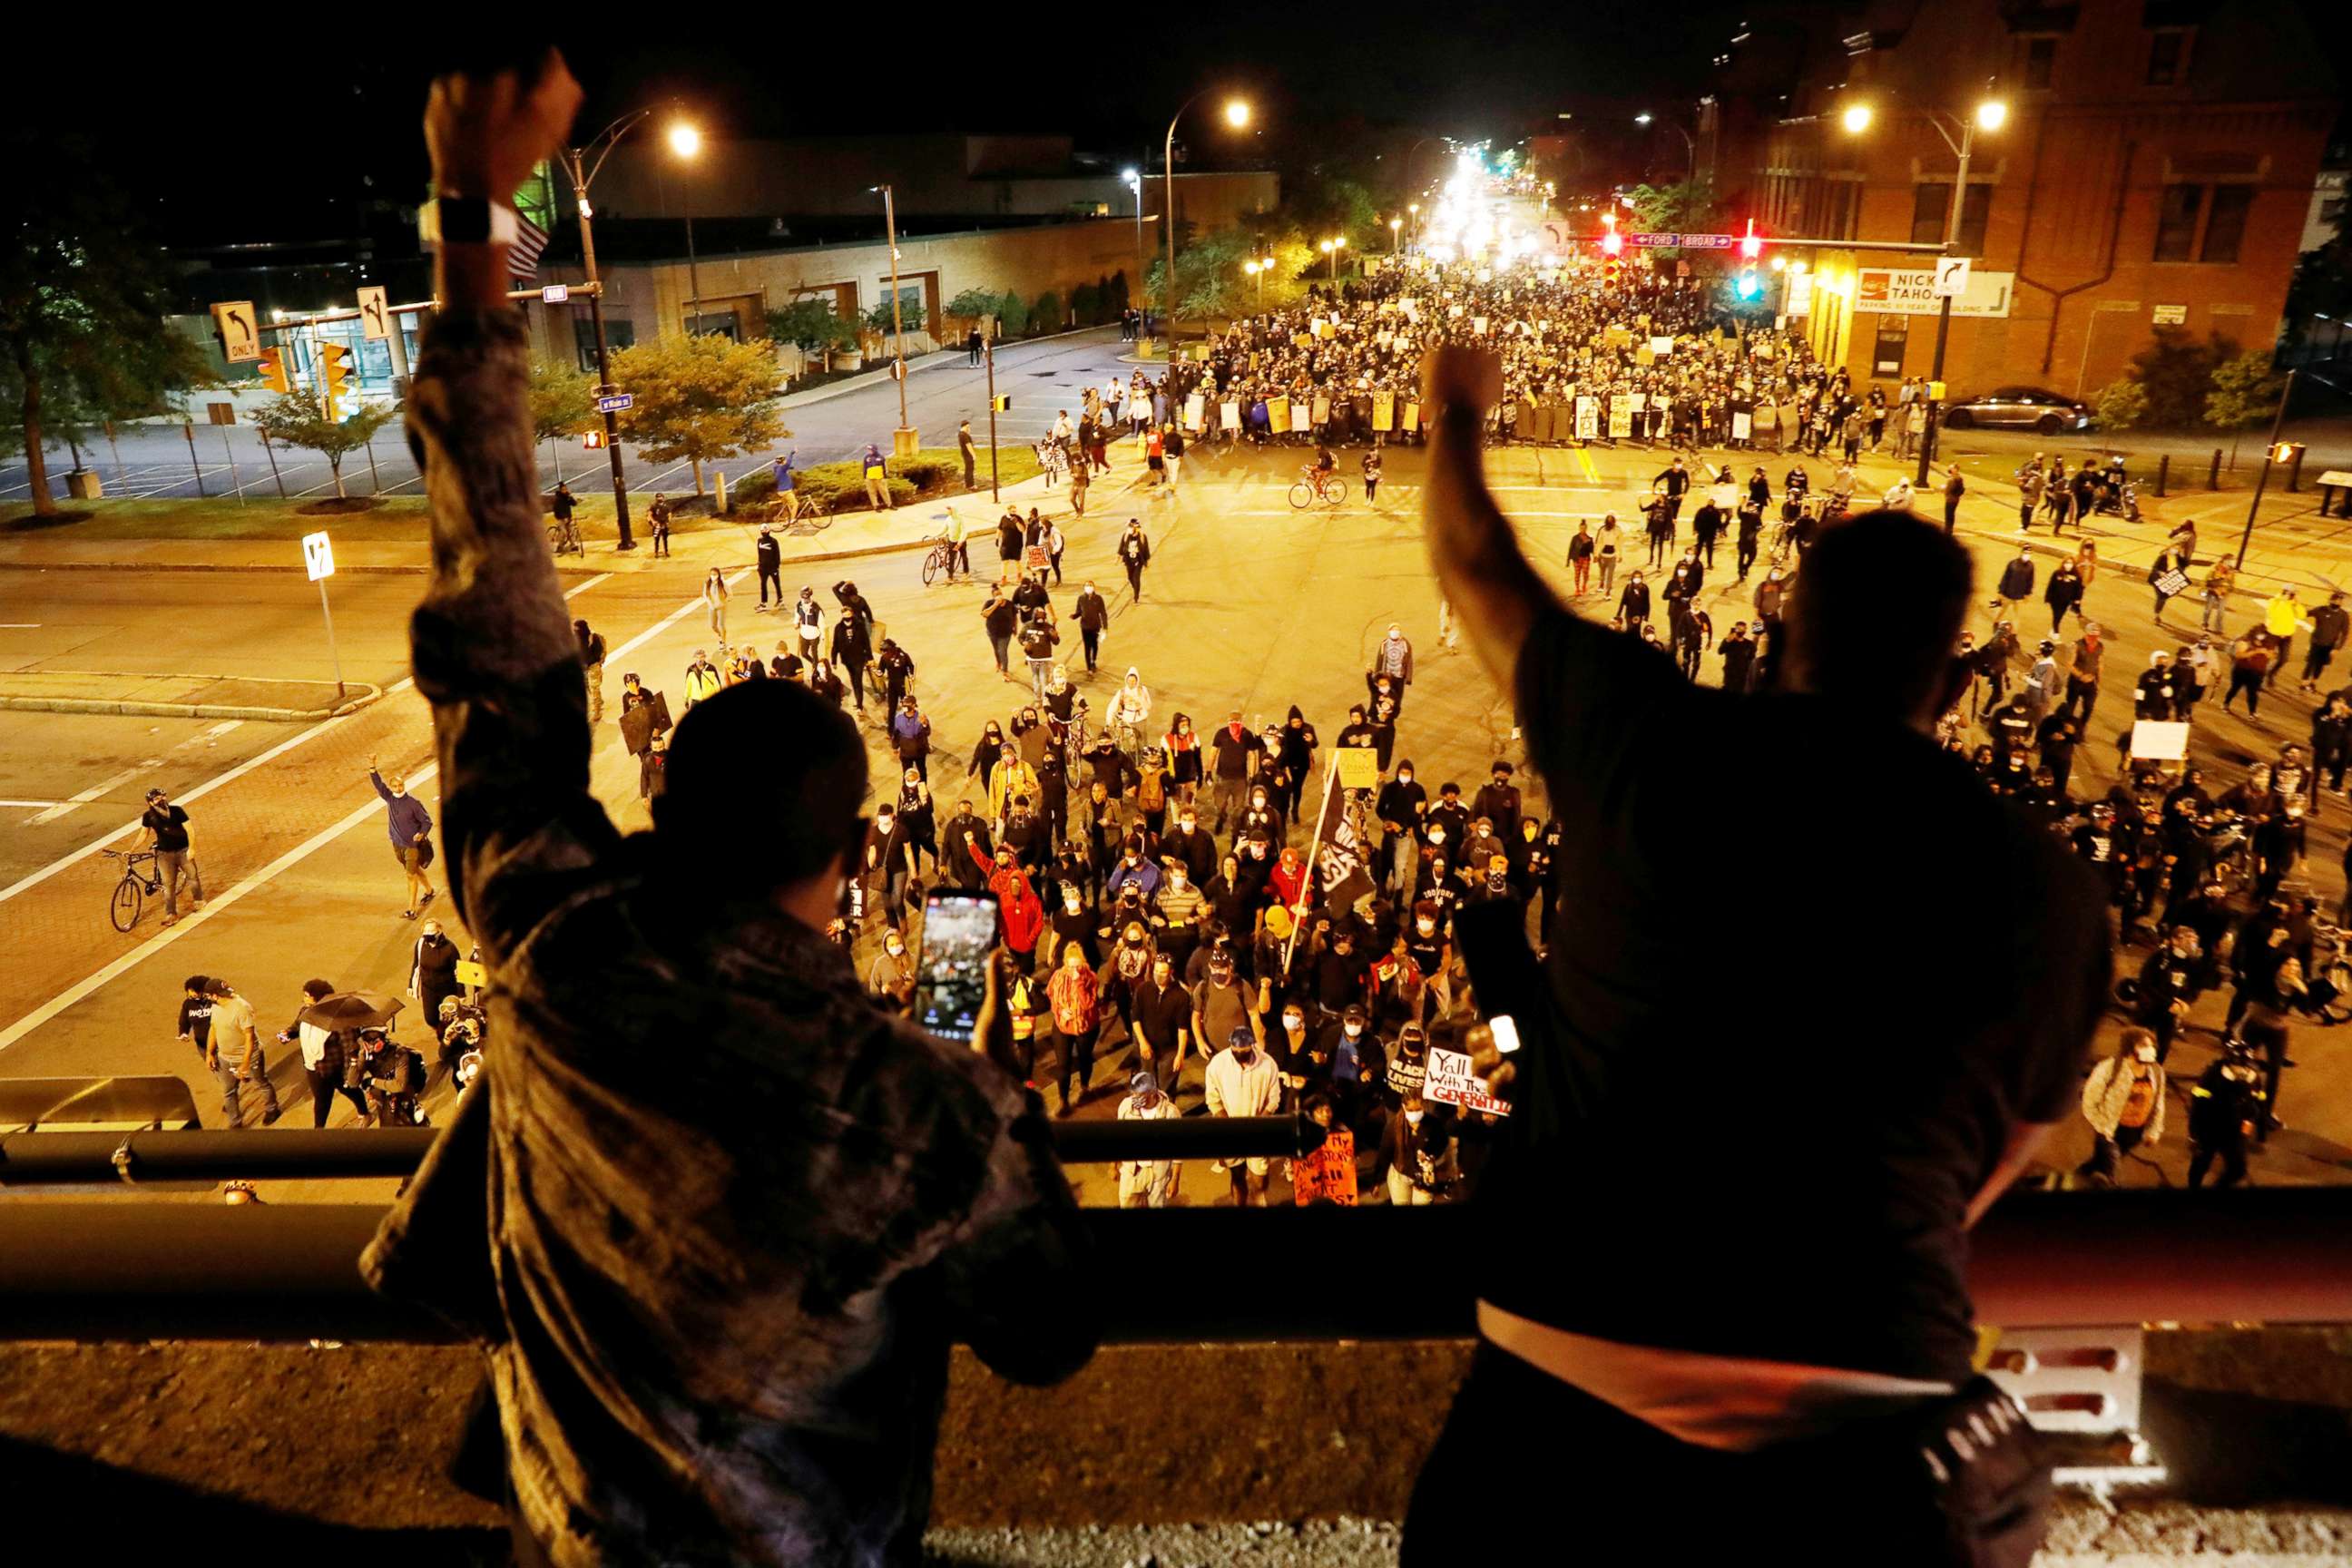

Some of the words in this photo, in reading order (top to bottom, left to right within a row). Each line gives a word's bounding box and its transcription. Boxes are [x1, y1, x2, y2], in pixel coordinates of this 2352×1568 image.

[1648, 236, 1673, 245] FORD
[1685, 236, 1716, 247] BROAD
[1897, 275, 1936, 287] NICK
[231, 344, 254, 357] ONLY
[1387, 1070, 1425, 1088] LIVES
